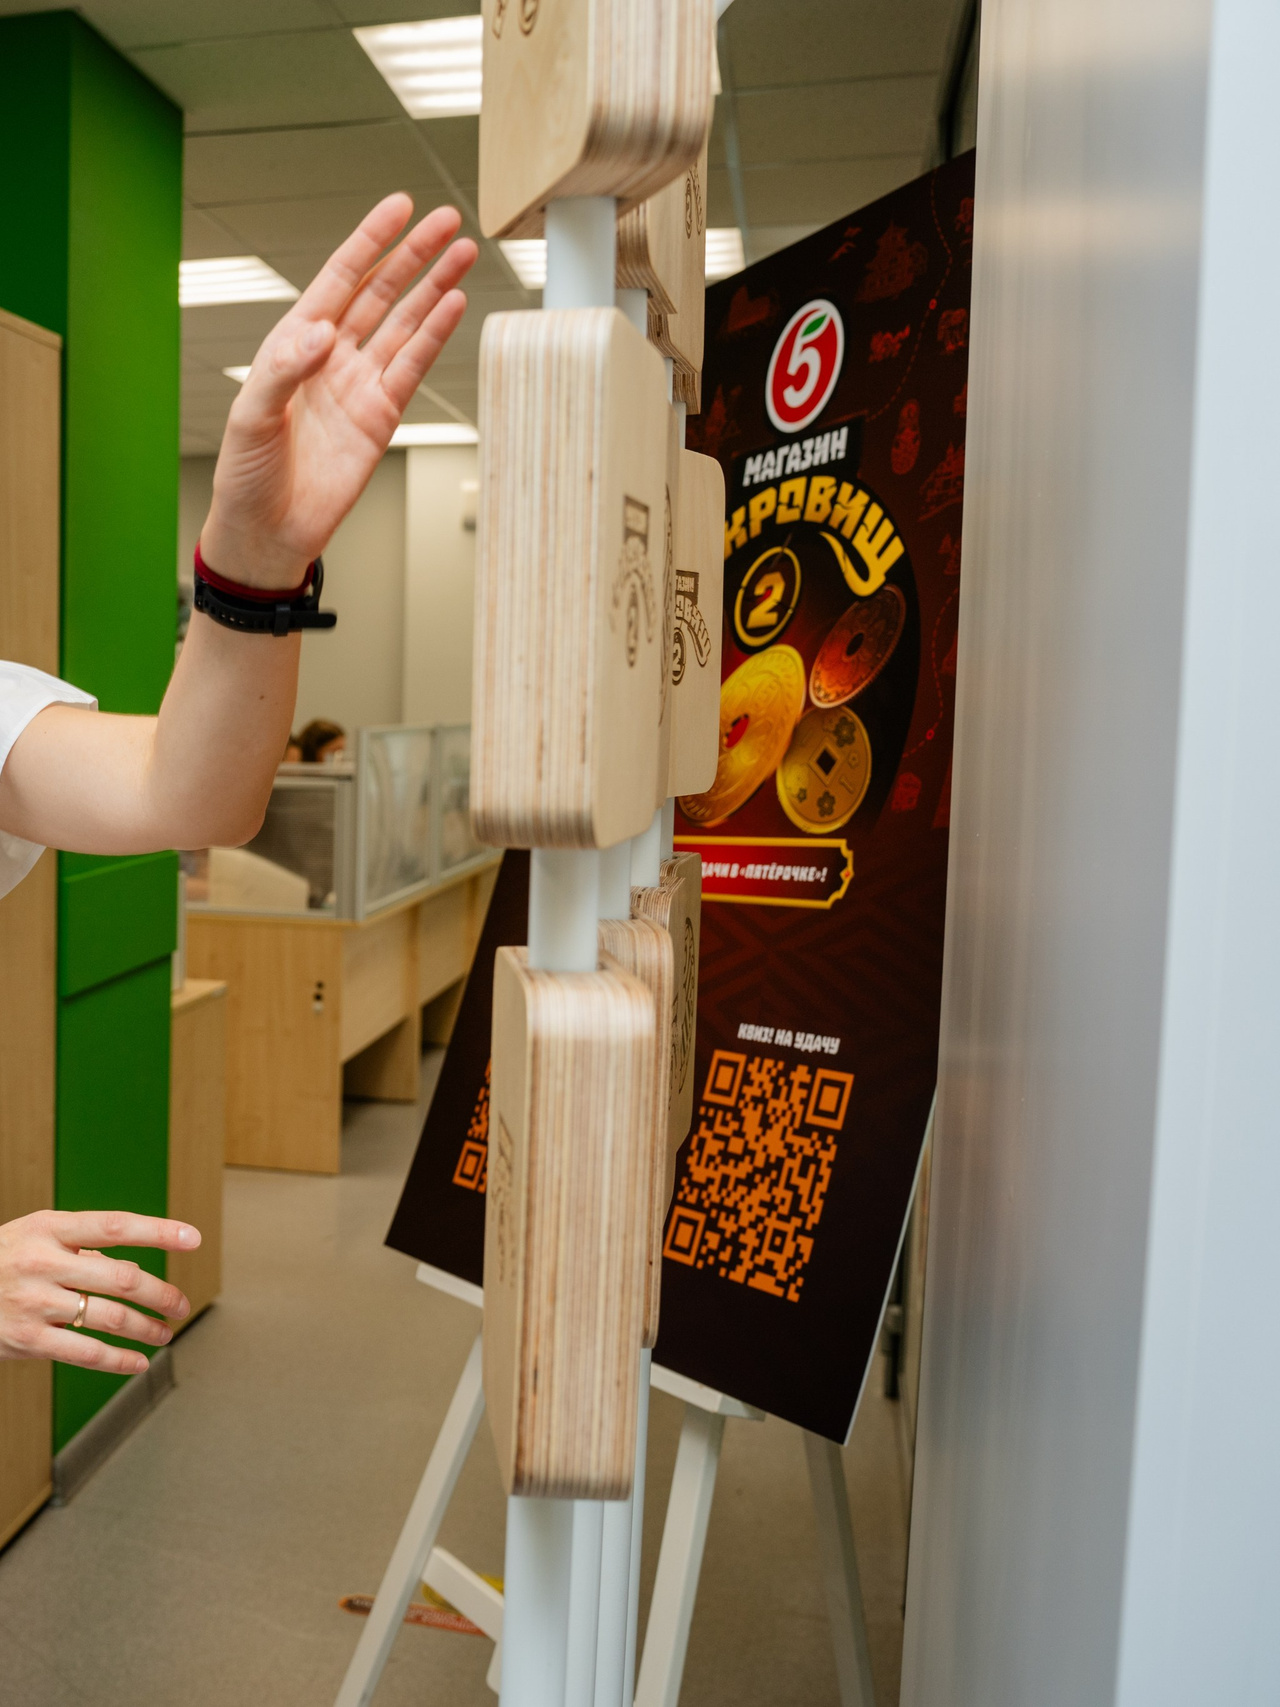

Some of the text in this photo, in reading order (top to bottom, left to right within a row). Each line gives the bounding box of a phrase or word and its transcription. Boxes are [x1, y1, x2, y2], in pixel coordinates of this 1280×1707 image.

[783, 308, 828, 408] 5
[742, 425, 849, 488] МАГАЗИН
[724, 475, 905, 597] КРОВИЩ
[746, 571, 786, 629] 2
[701, 861, 730, 879] ДАЧИ
[729, 862, 740, 879] В
[774, 1029, 793, 1048] НА
[793, 1031, 841, 1055] УДАЧУ
